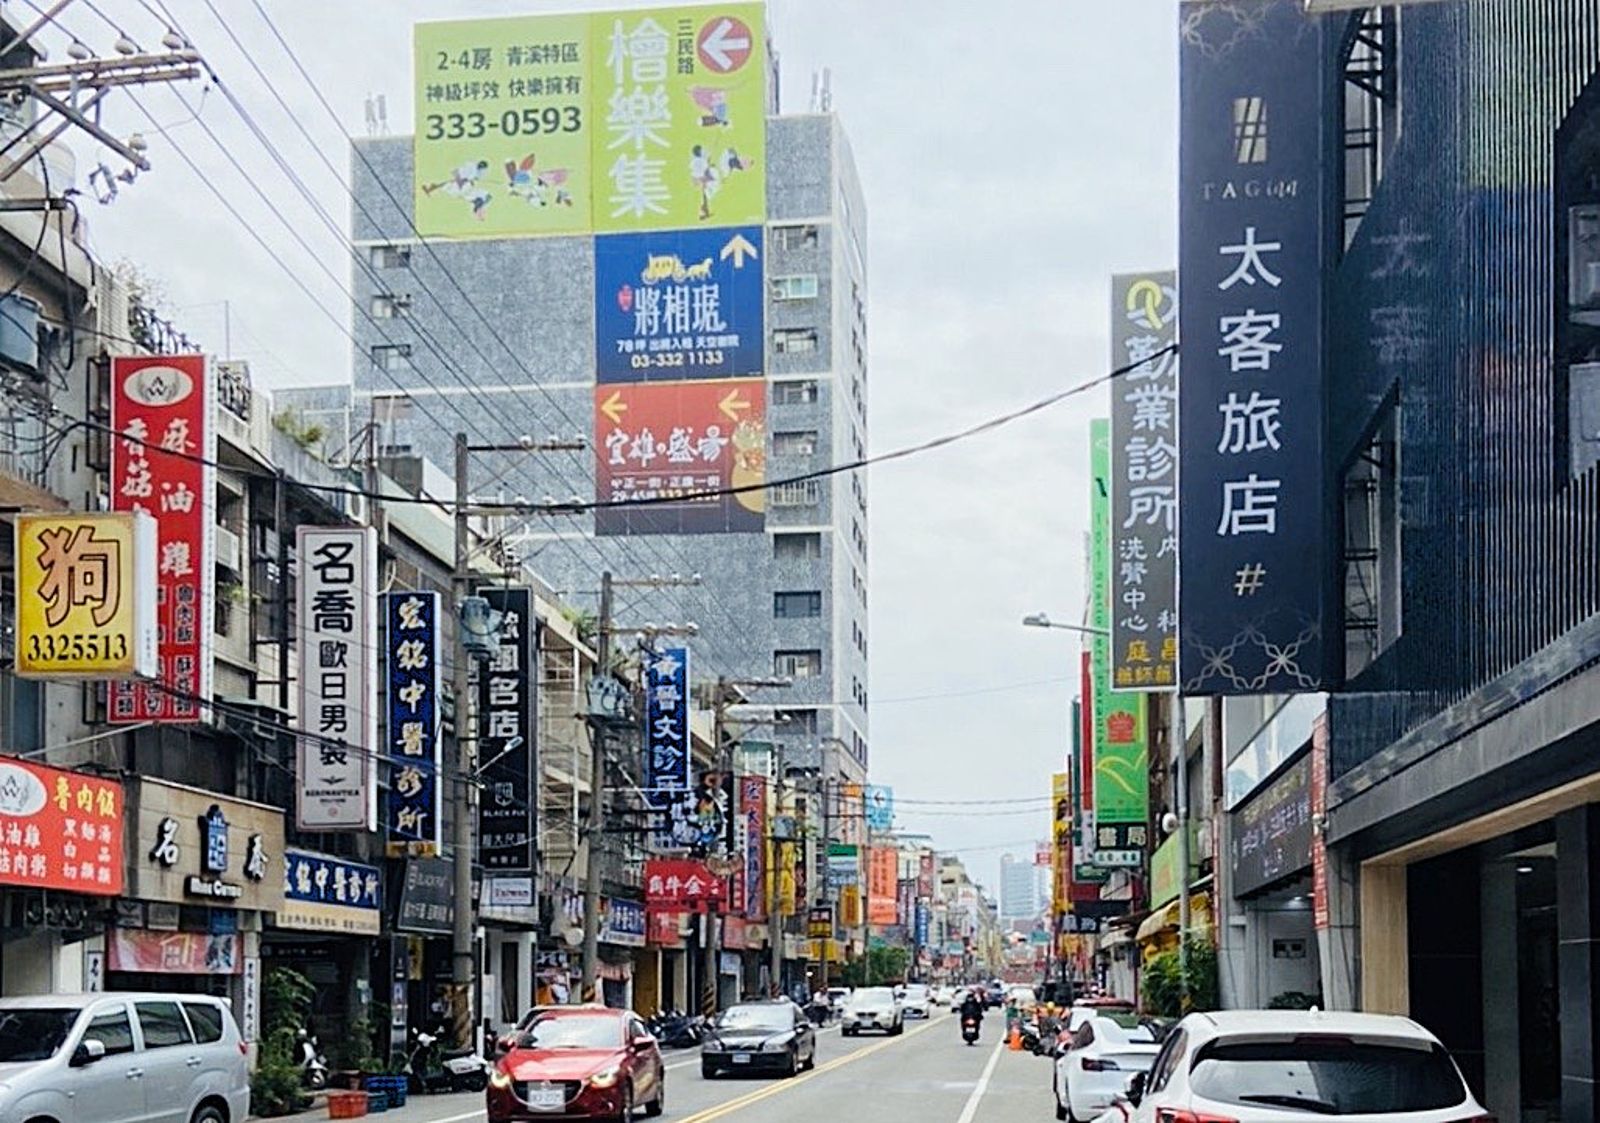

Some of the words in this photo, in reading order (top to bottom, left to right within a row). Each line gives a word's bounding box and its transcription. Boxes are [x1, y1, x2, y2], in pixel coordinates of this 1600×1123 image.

[437, 47, 492, 70] 2-4房
[677, 19, 694, 75] 三民路
[426, 106, 581, 140] 333-0593
[607, 18, 671, 219] 檜樂集
[631, 353, 684, 368] 03-332
[689, 351, 723, 365] 1133
[1218, 227, 1282, 536] 太客旅店
[36, 525, 121, 627] 狗
[27, 633, 128, 662] 3325513
[1099, 826, 1147, 848] 書局
